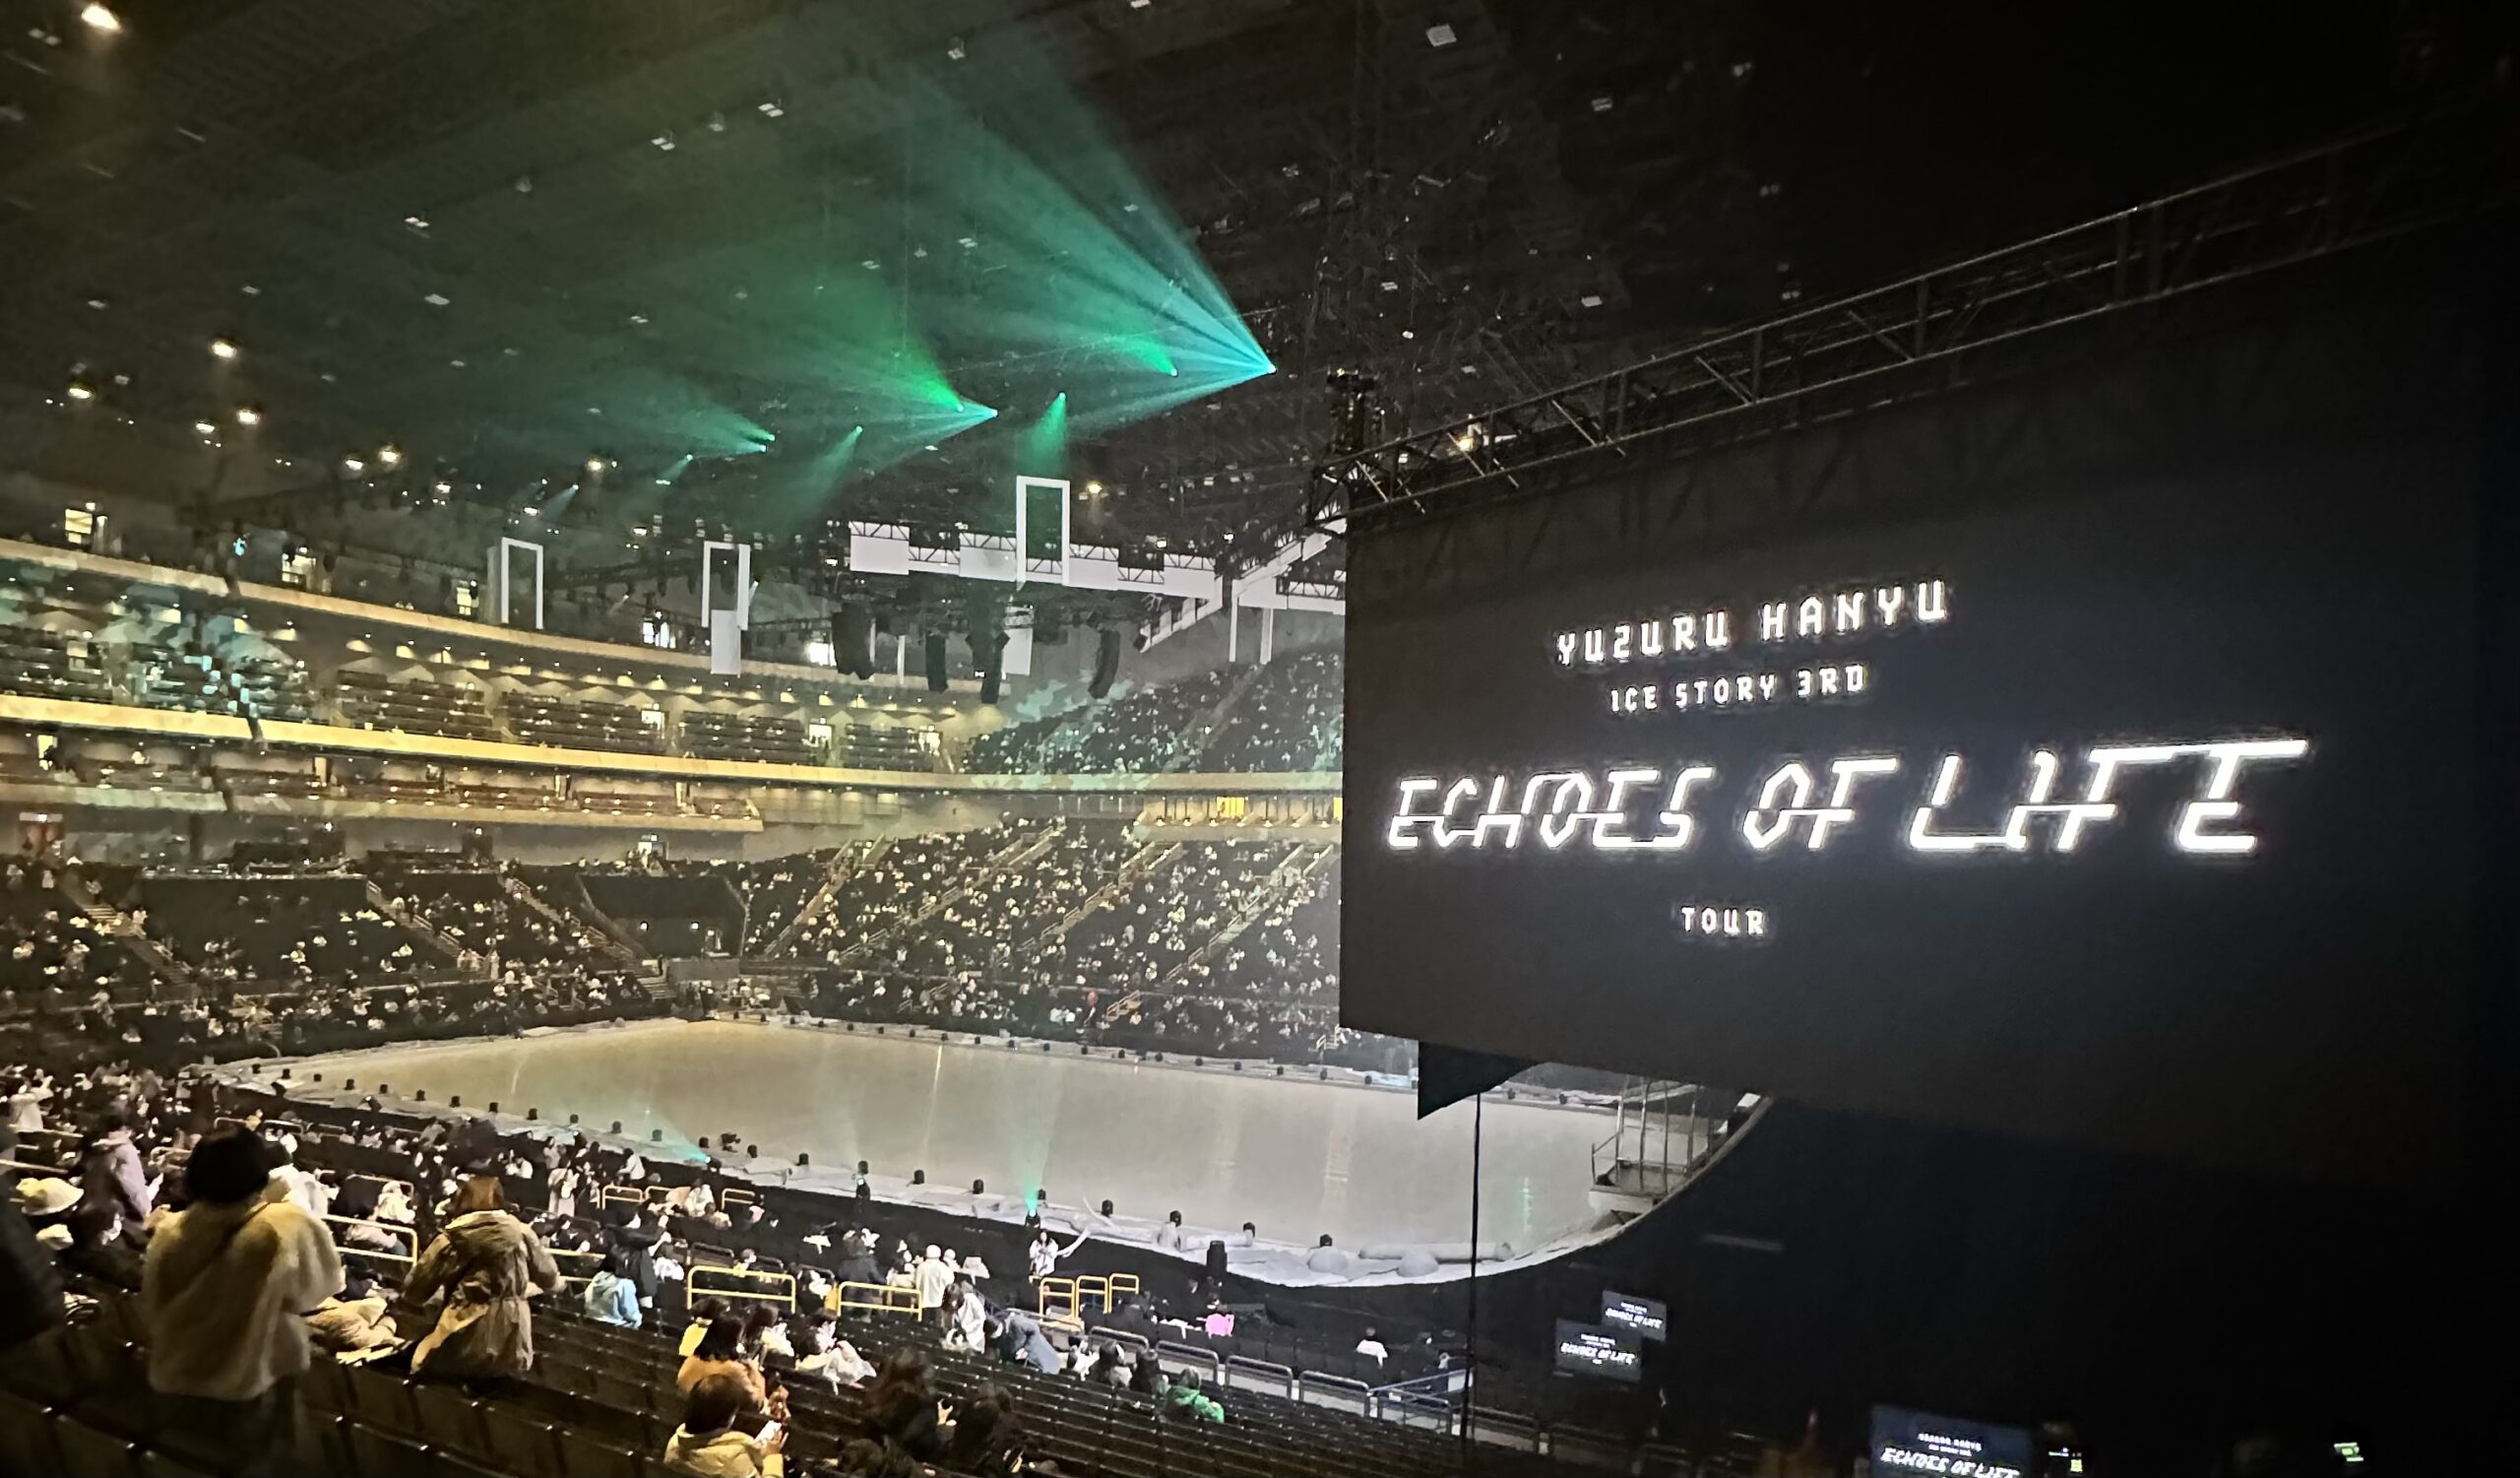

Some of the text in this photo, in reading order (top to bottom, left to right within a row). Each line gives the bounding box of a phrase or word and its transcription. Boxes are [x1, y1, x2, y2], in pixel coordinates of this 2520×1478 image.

[1555, 578, 1948, 667] YUZURU HANYU
[1609, 662, 1868, 715] ICE STORY 3RD
[1385, 737, 2310, 854] ECHOES OF LIFE
[1680, 905, 1766, 937] TOUR
